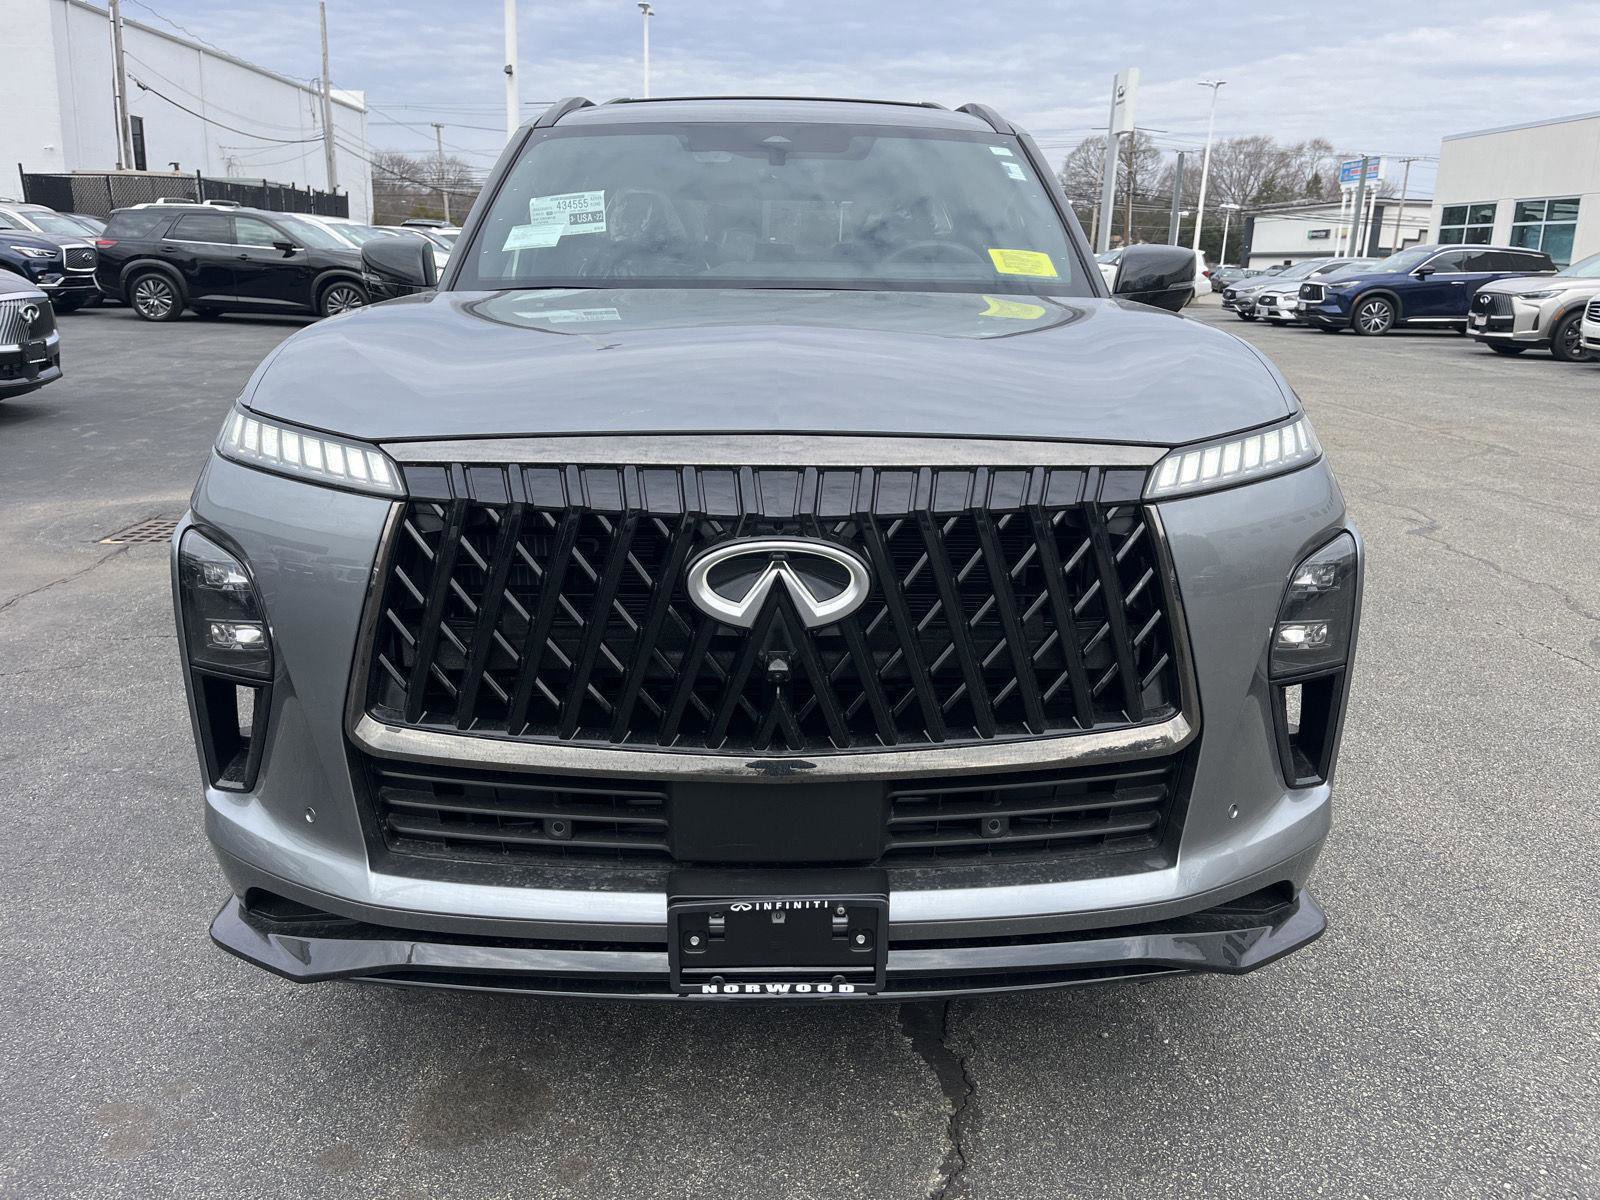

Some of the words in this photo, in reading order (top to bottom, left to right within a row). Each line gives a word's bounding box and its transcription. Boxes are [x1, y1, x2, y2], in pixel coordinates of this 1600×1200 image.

[556, 199, 588, 210] 434555
[577, 213, 593, 223] USA
[756, 900, 828, 910] INFINITI
[702, 984, 855, 993] NORWOOD
